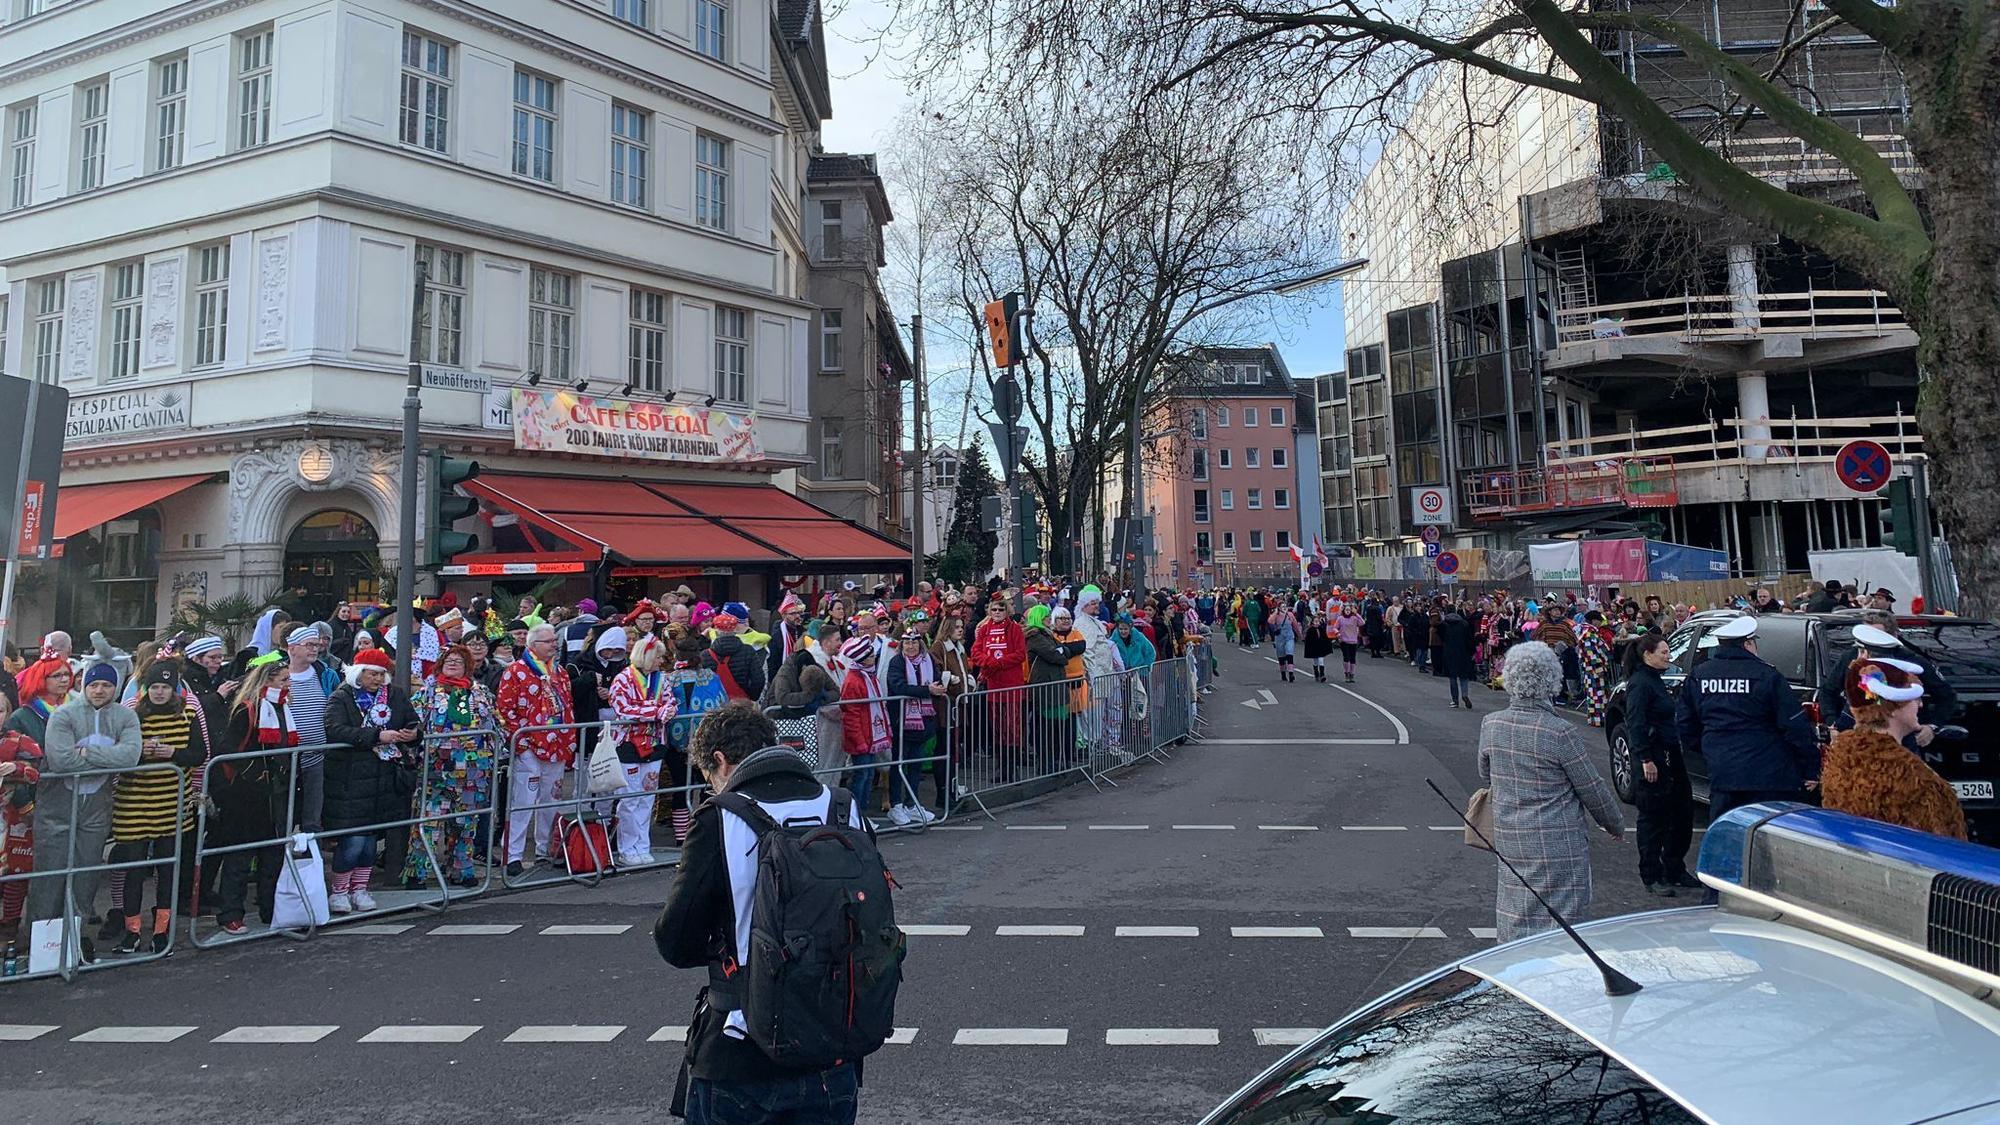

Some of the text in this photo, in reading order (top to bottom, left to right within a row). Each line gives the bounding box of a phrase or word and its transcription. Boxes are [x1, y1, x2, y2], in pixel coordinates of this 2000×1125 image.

[426, 370, 488, 391] Neuhöfferstr.
[66, 408, 185, 437] ESTAURANT CANTINA
[624, 410, 713, 436] ESPECIAL
[566, 428, 590, 446] 200
[592, 431, 627, 449] JAHRE
[628, 433, 668, 453] KÖLNER
[670, 437, 721, 457] KARNEVAL
[1425, 496, 1439, 507] 30
[1428, 544, 1437, 557] P
[1701, 679, 1750, 693] POLIZEI
[1962, 783, 1993, 797] 5284
